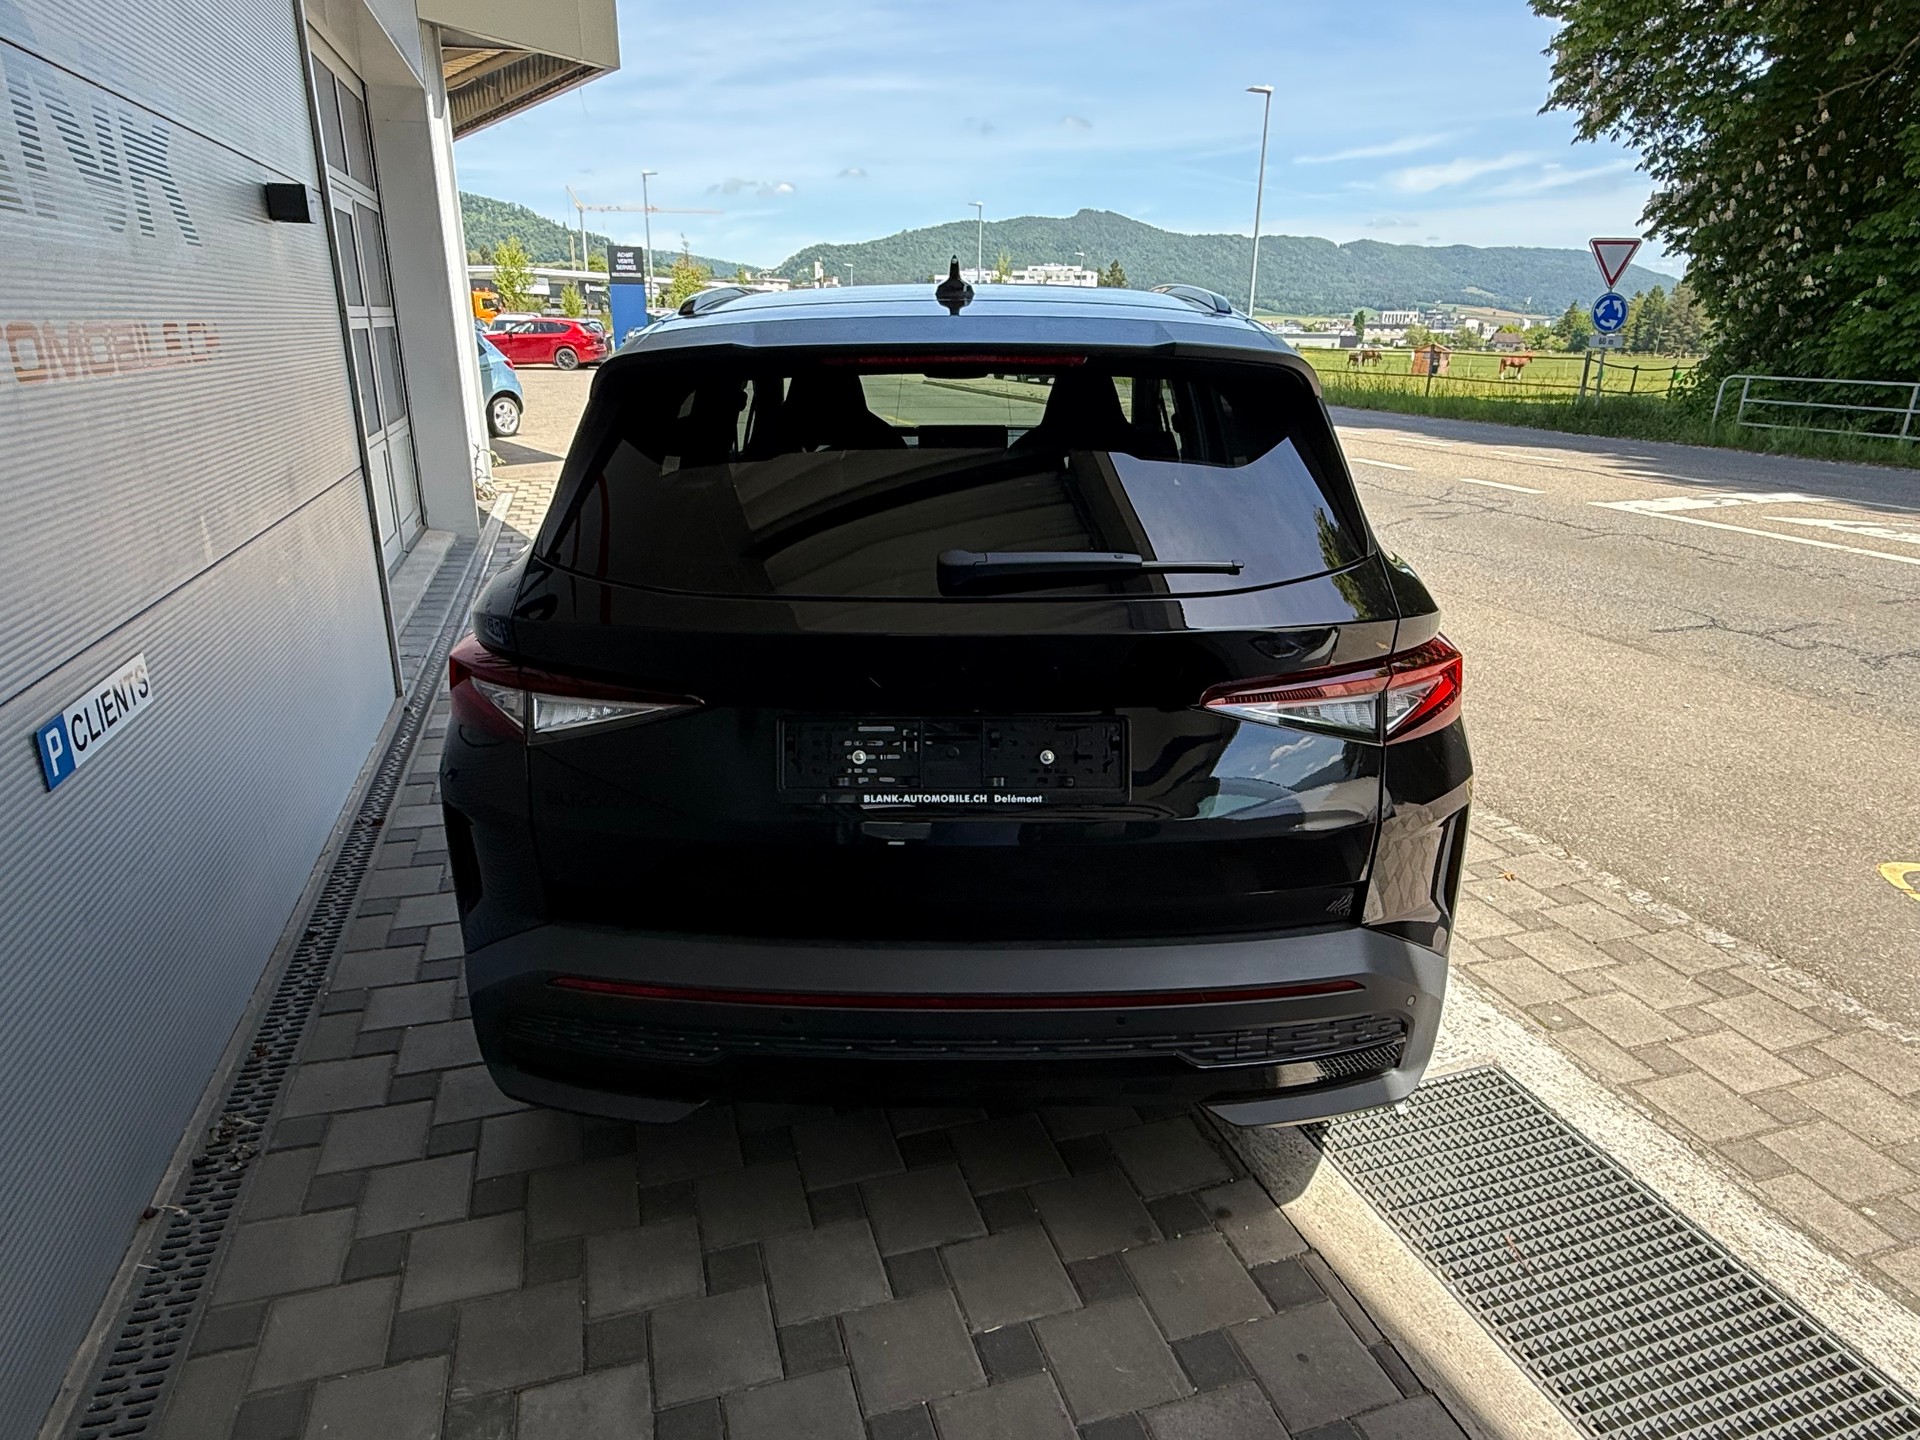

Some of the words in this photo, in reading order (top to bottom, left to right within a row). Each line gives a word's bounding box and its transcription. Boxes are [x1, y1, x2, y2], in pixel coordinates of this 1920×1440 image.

[45, 727, 63, 777] P
[71, 664, 149, 752] CLIENTS
[863, 794, 988, 804] BLANK-AUTOMOBILE.CH
[994, 794, 1043, 804] Delémont
